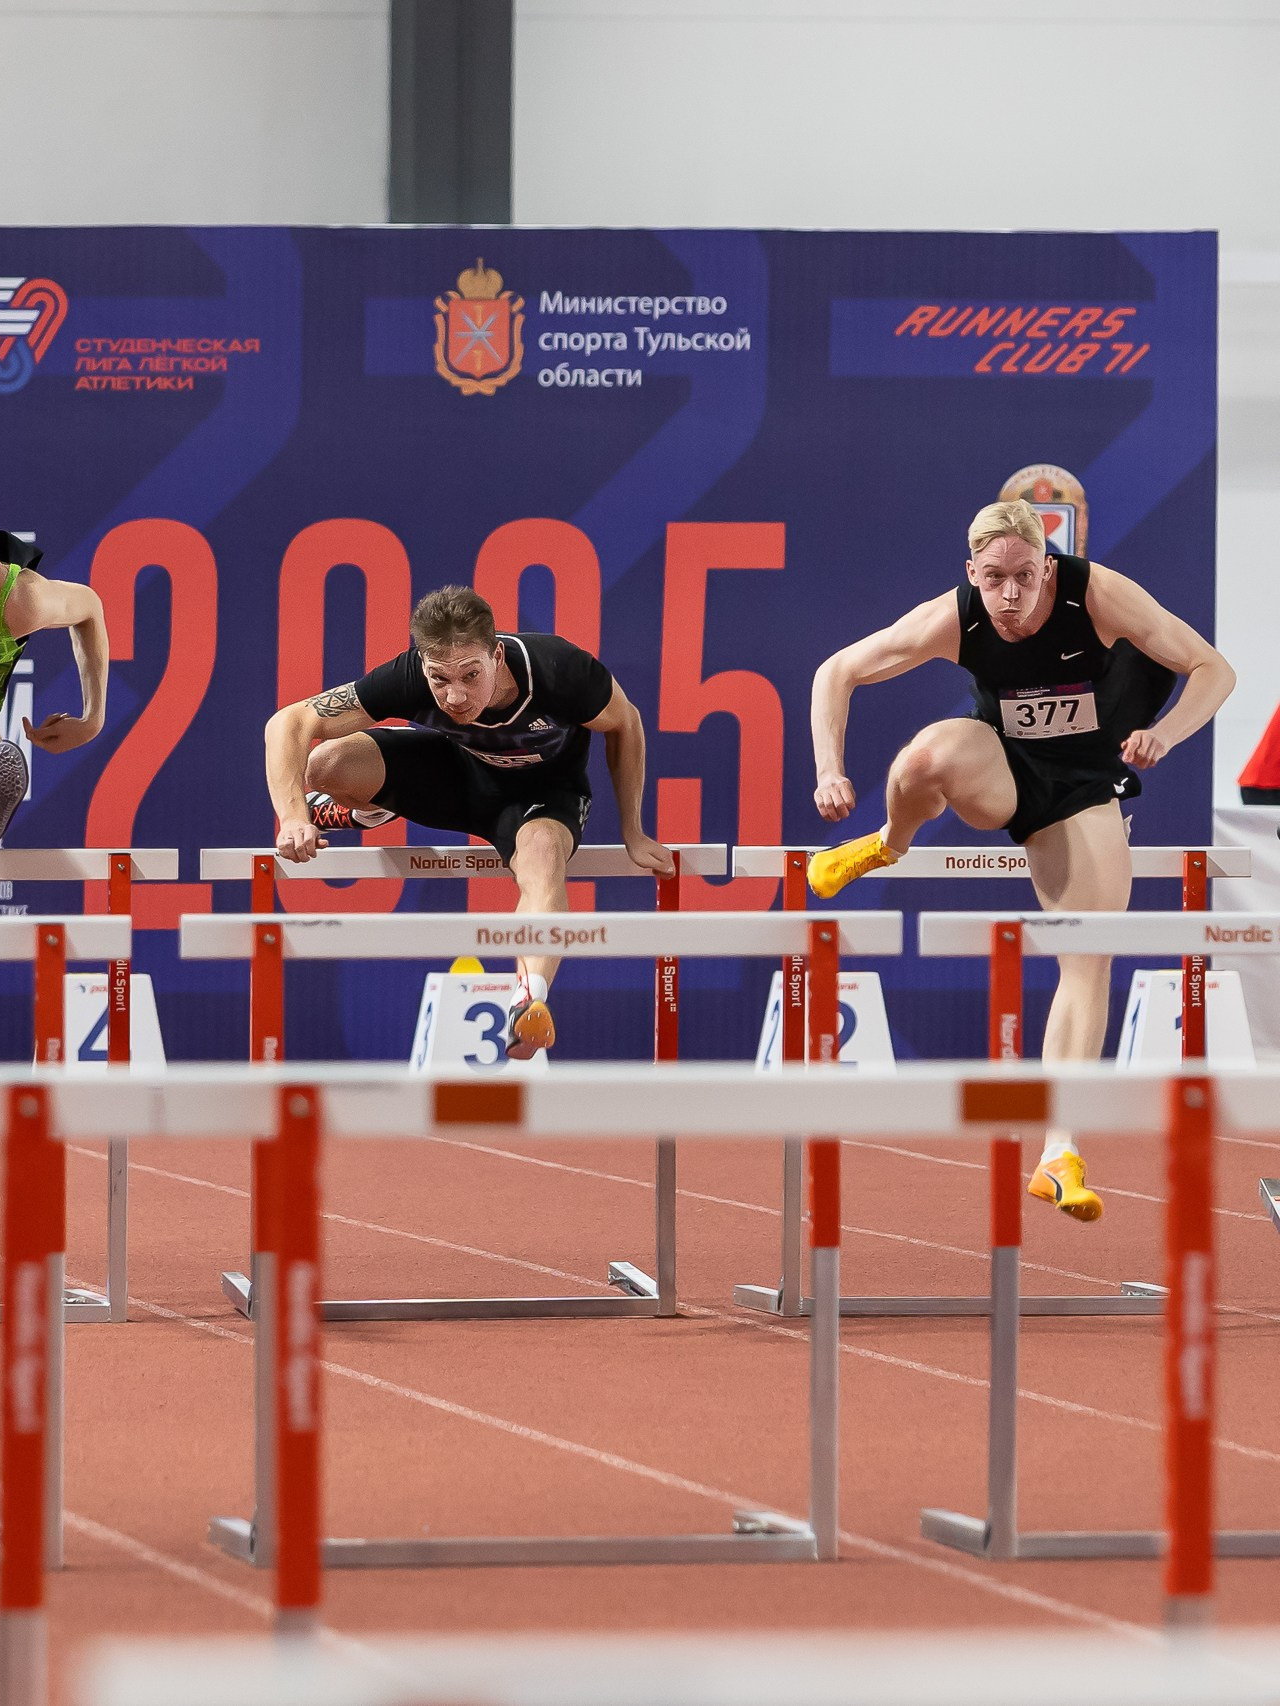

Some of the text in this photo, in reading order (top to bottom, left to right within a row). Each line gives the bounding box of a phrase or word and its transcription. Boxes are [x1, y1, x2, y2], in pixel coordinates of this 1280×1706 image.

[539, 290, 727, 320] Министерство
[894, 306, 1137, 338] RUNNERS
[75, 338, 261, 353] СТУДЕНЧЕСКАЯ
[538, 327, 751, 357] спорта Тульской
[75, 357, 132, 372] ЛИГА
[974, 342, 1151, 373] CLUB 71
[75, 376, 194, 390] АТЛЕТИКИ
[538, 362, 642, 387] области
[1015, 699, 1080, 727] 377
[410, 855, 461, 869] Nordic
[997, 856, 1027, 871] Spo
[549, 925, 607, 947] Sport
[114, 978, 126, 1012] Sport
[662, 966, 676, 1002] Sport
[789, 974, 802, 1007] Sport
[1189, 974, 1202, 1007] Sport
[464, 1002, 508, 1073] 3
